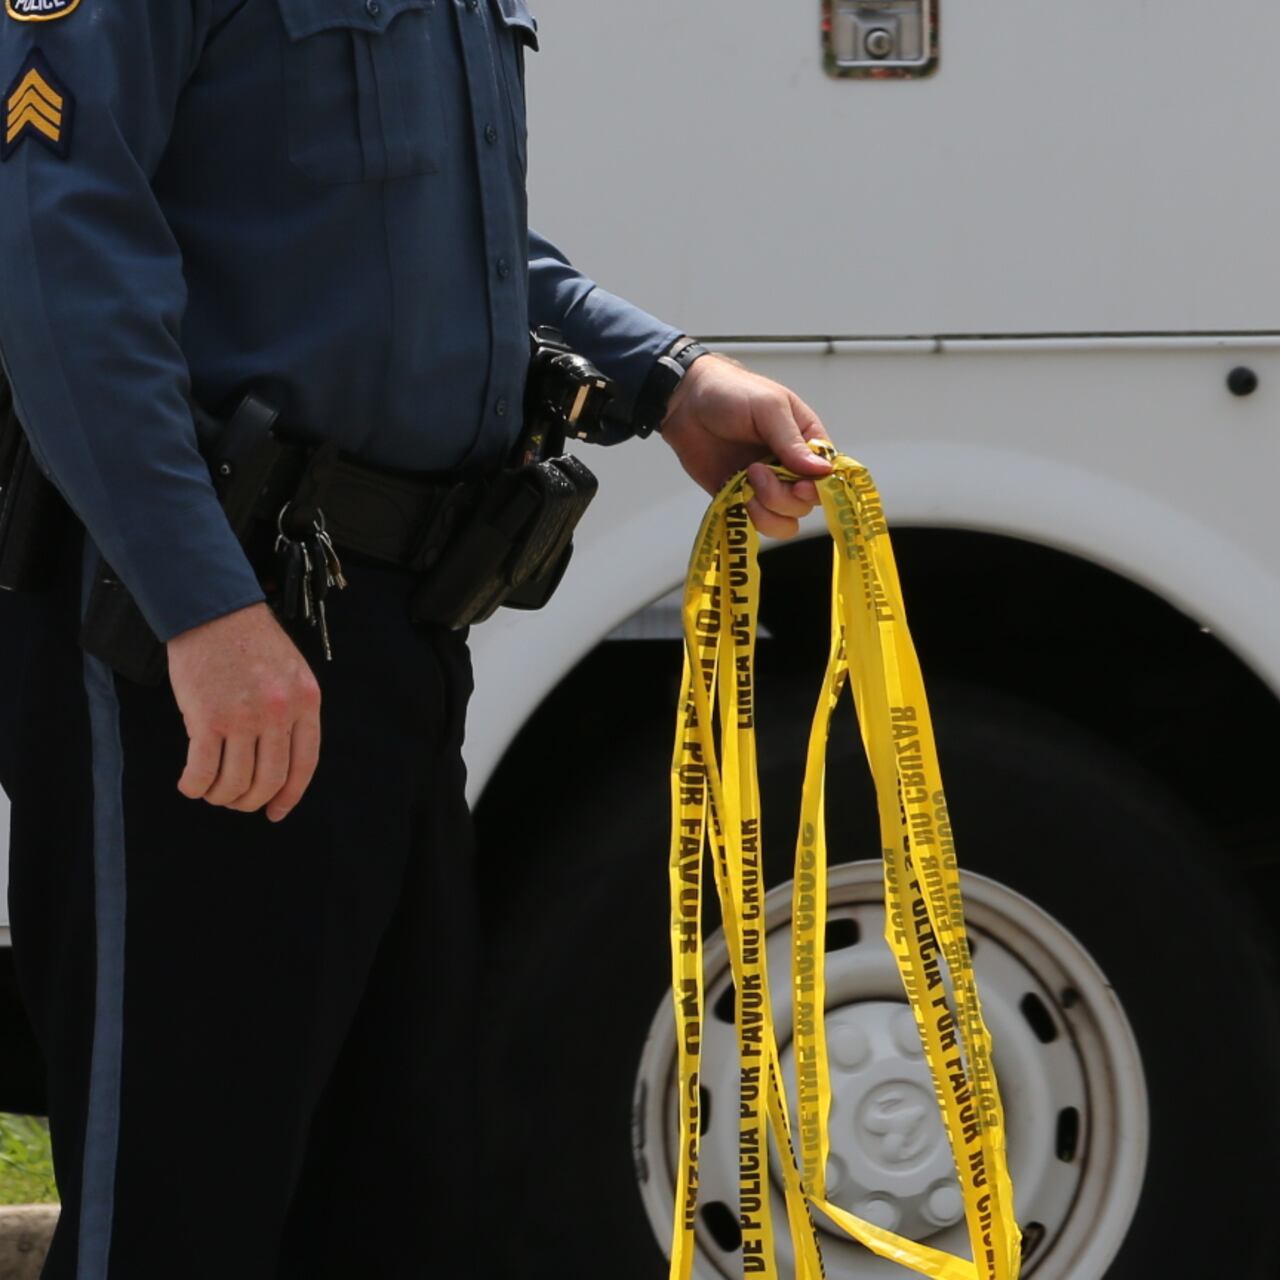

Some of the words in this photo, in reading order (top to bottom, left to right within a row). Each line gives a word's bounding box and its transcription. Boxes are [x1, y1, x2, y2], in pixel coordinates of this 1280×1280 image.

[725, 501, 750, 604] POLICIA
[739, 818, 762, 922] CRUZAR
[740, 973, 763, 1059] FAVOR
[739, 1064, 761, 1118] POR
[739, 1123, 761, 1225] POLICIA
[740, 1232, 762, 1275] DE
